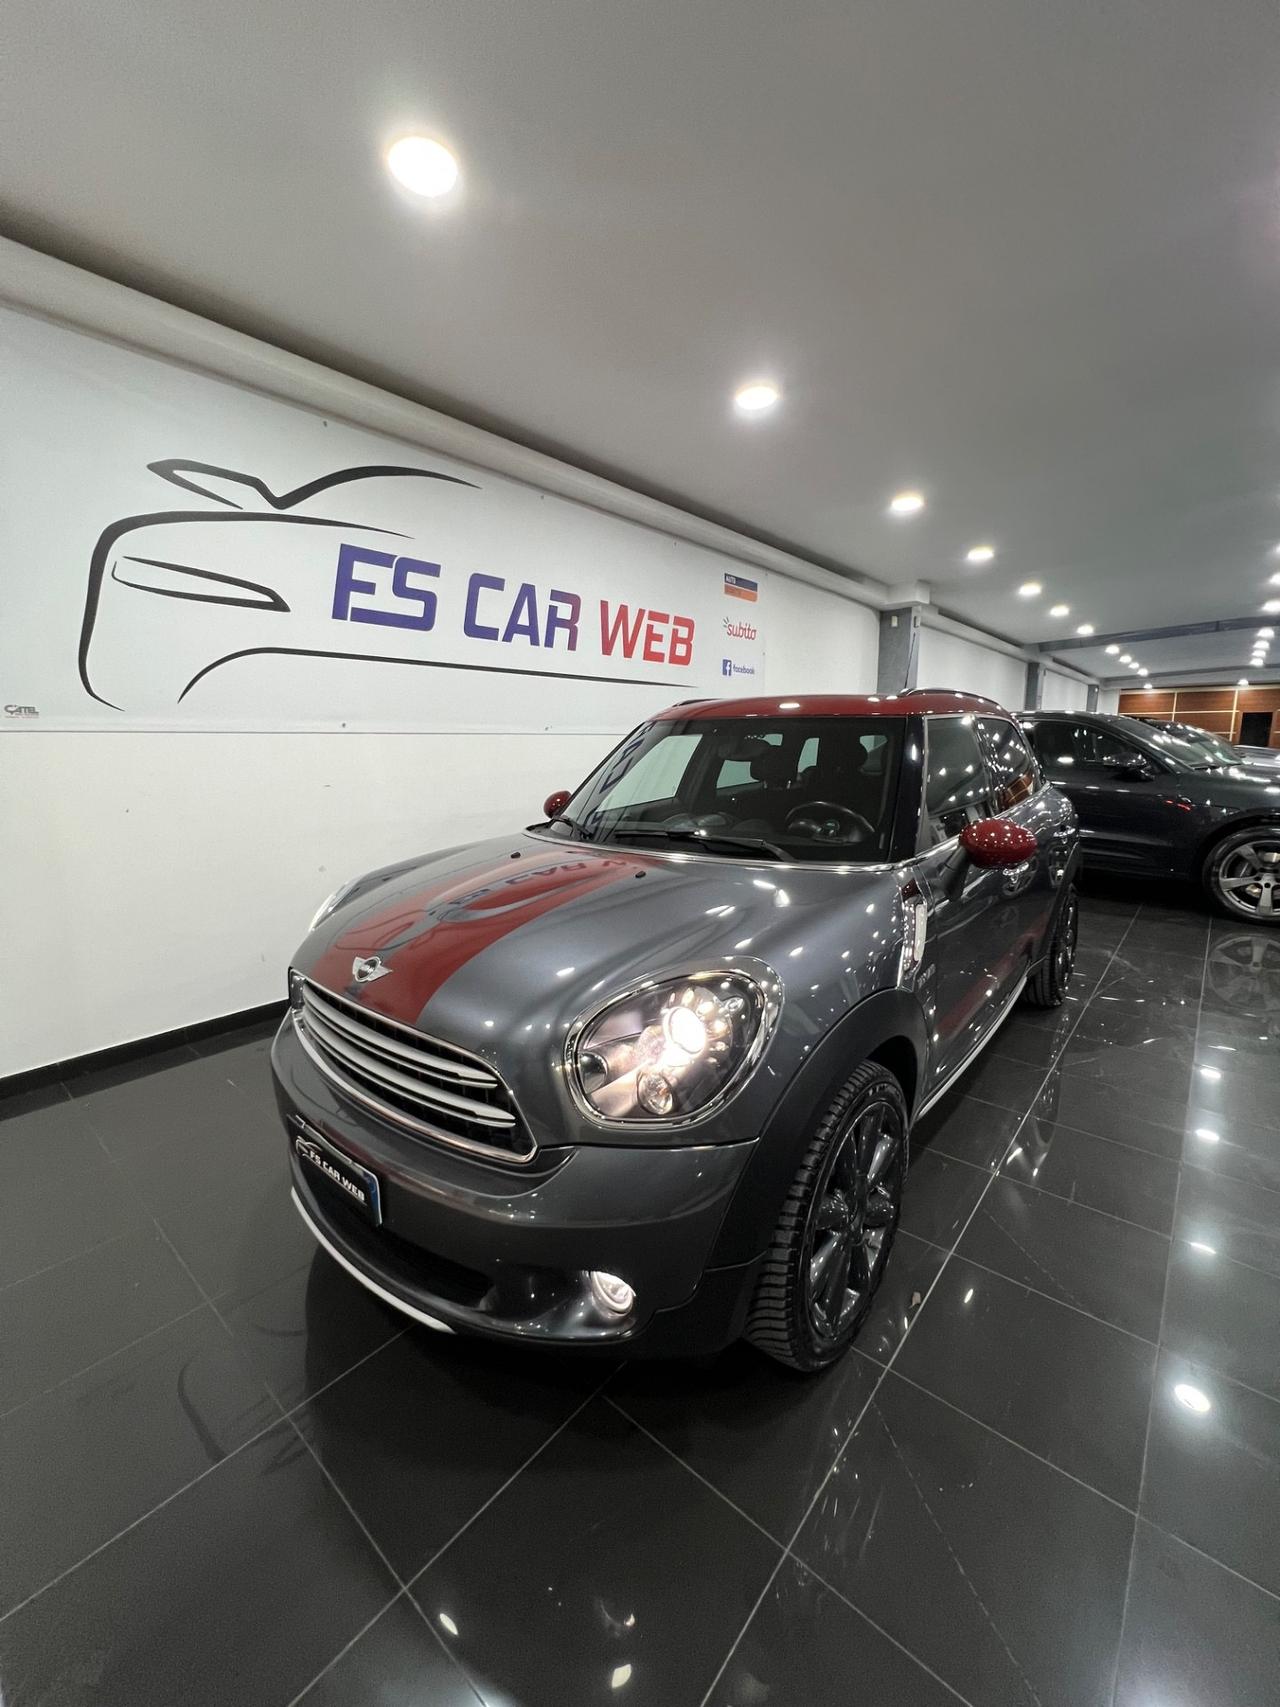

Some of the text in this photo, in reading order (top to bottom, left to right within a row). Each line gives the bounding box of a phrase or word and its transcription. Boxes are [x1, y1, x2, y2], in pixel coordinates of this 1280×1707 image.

[331, 543, 695, 666] ES CAR WEB
[726, 621, 757, 641] subito
[733, 663, 755, 675] facebook
[322, 1161, 341, 1181] CAR
[342, 1176, 365, 1201] WEB
